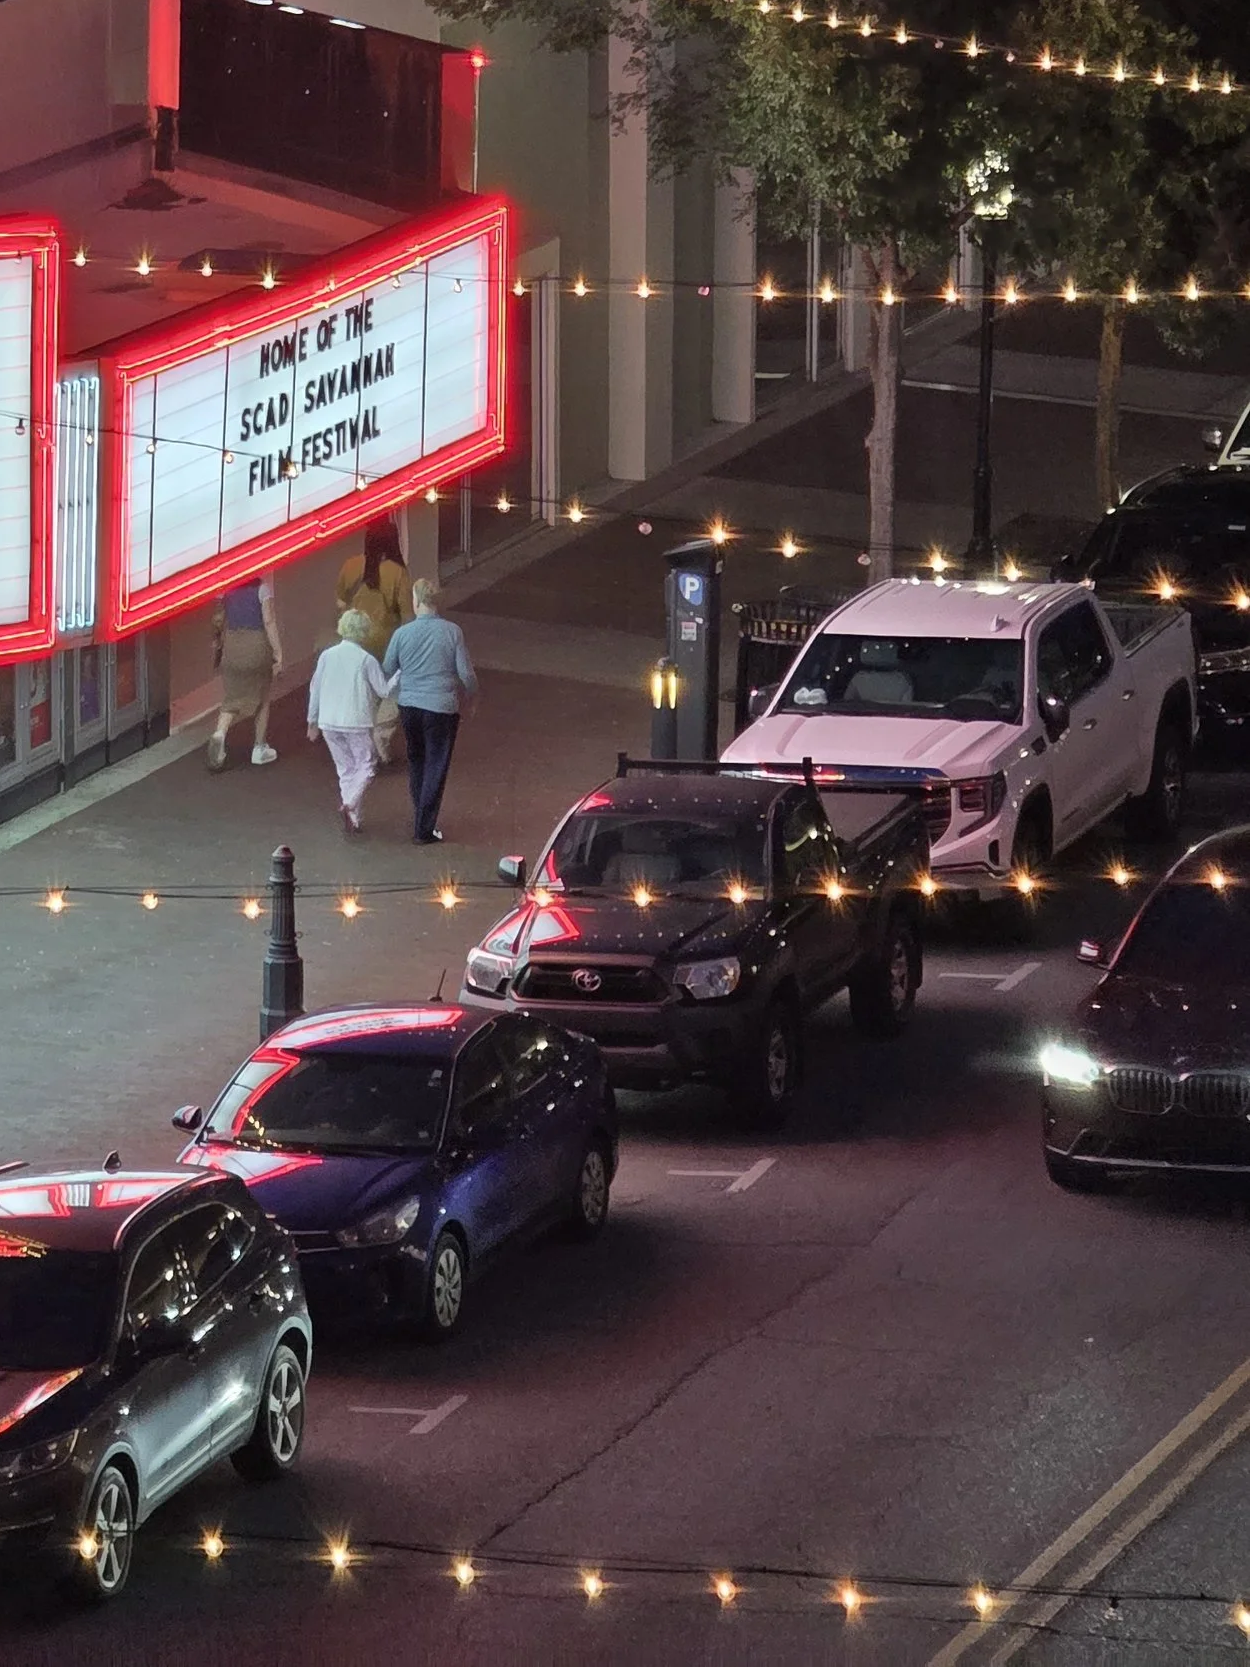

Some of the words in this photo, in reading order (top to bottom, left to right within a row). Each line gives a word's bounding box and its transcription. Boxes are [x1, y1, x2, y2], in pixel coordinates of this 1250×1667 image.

[259, 327, 309, 378] HOME
[316, 314, 337, 352] OF
[345, 298, 374, 341] THE
[239, 392, 290, 441] SCAD
[303, 342, 396, 414] SAVANNAH
[248, 446, 294, 497] FILM
[301, 406, 381, 472] FESTIVAL
[684, 577, 700, 600] P
